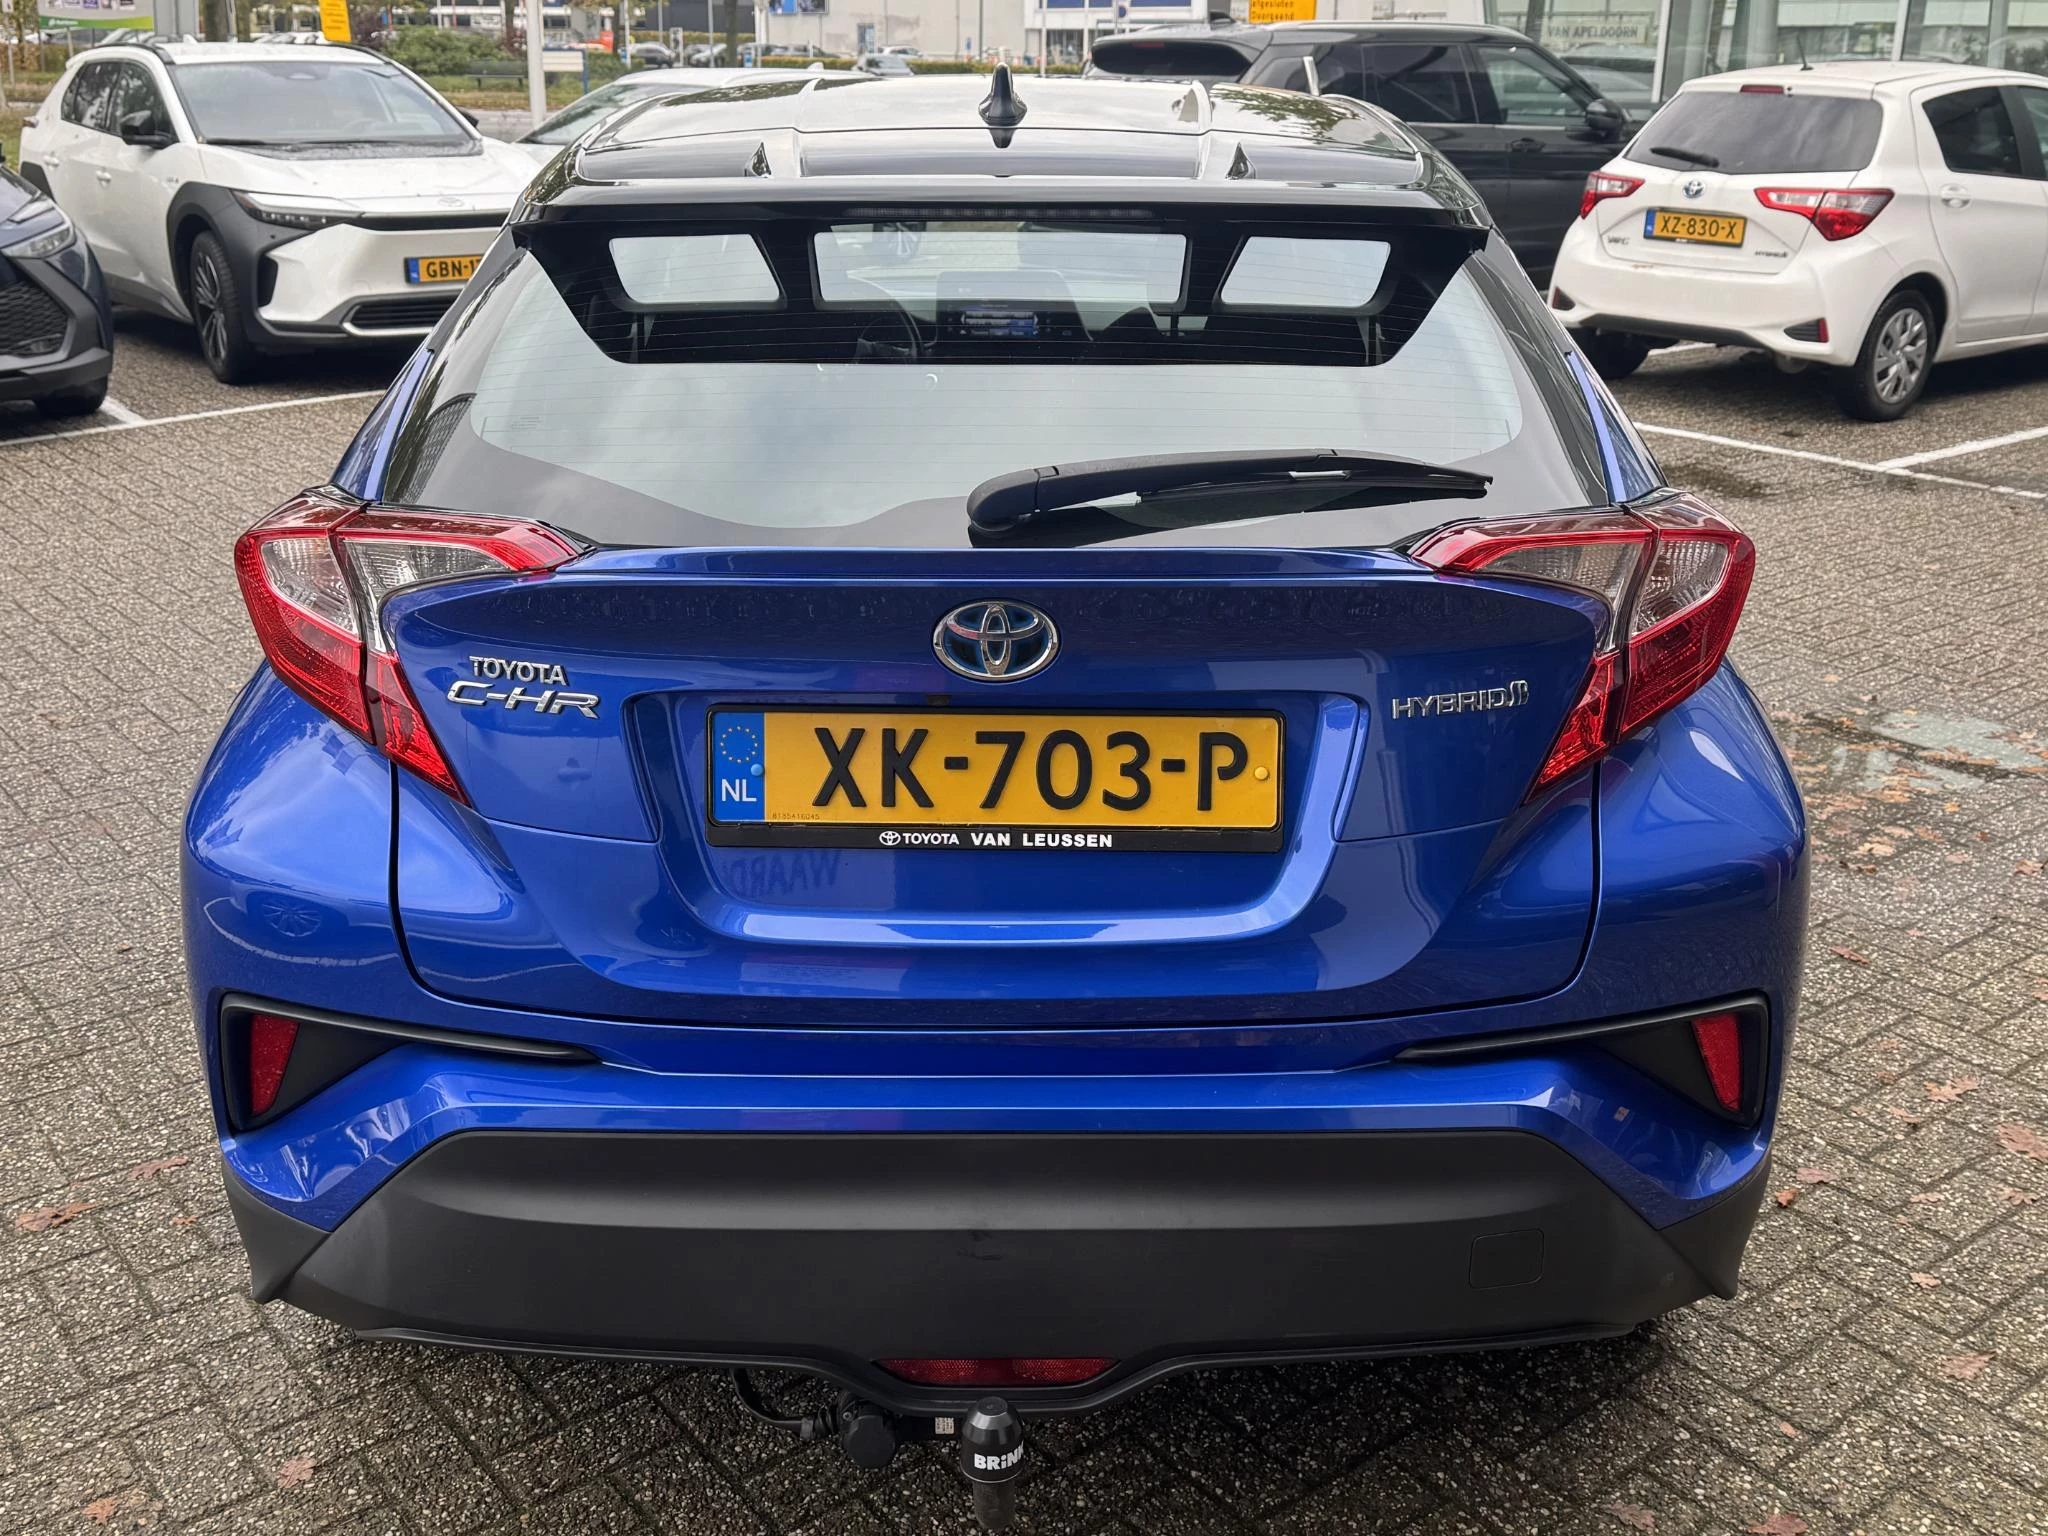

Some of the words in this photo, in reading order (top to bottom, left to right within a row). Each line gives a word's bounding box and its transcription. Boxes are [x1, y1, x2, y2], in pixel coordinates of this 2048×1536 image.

[1547, 25, 1570, 38] VAN
[1572, 25, 1639, 38] APELDOORN
[1660, 214, 1738, 240] XZ-830-X
[469, 655, 569, 686] TOYOTA
[447, 680, 600, 719] C-HR
[812, 728, 1249, 812] XK-703-P
[721, 778, 757, 802] NL
[902, 832, 960, 845] TOYOTA
[970, 832, 1011, 846] VAN
[1022, 833, 1113, 848] LEUSSEN
